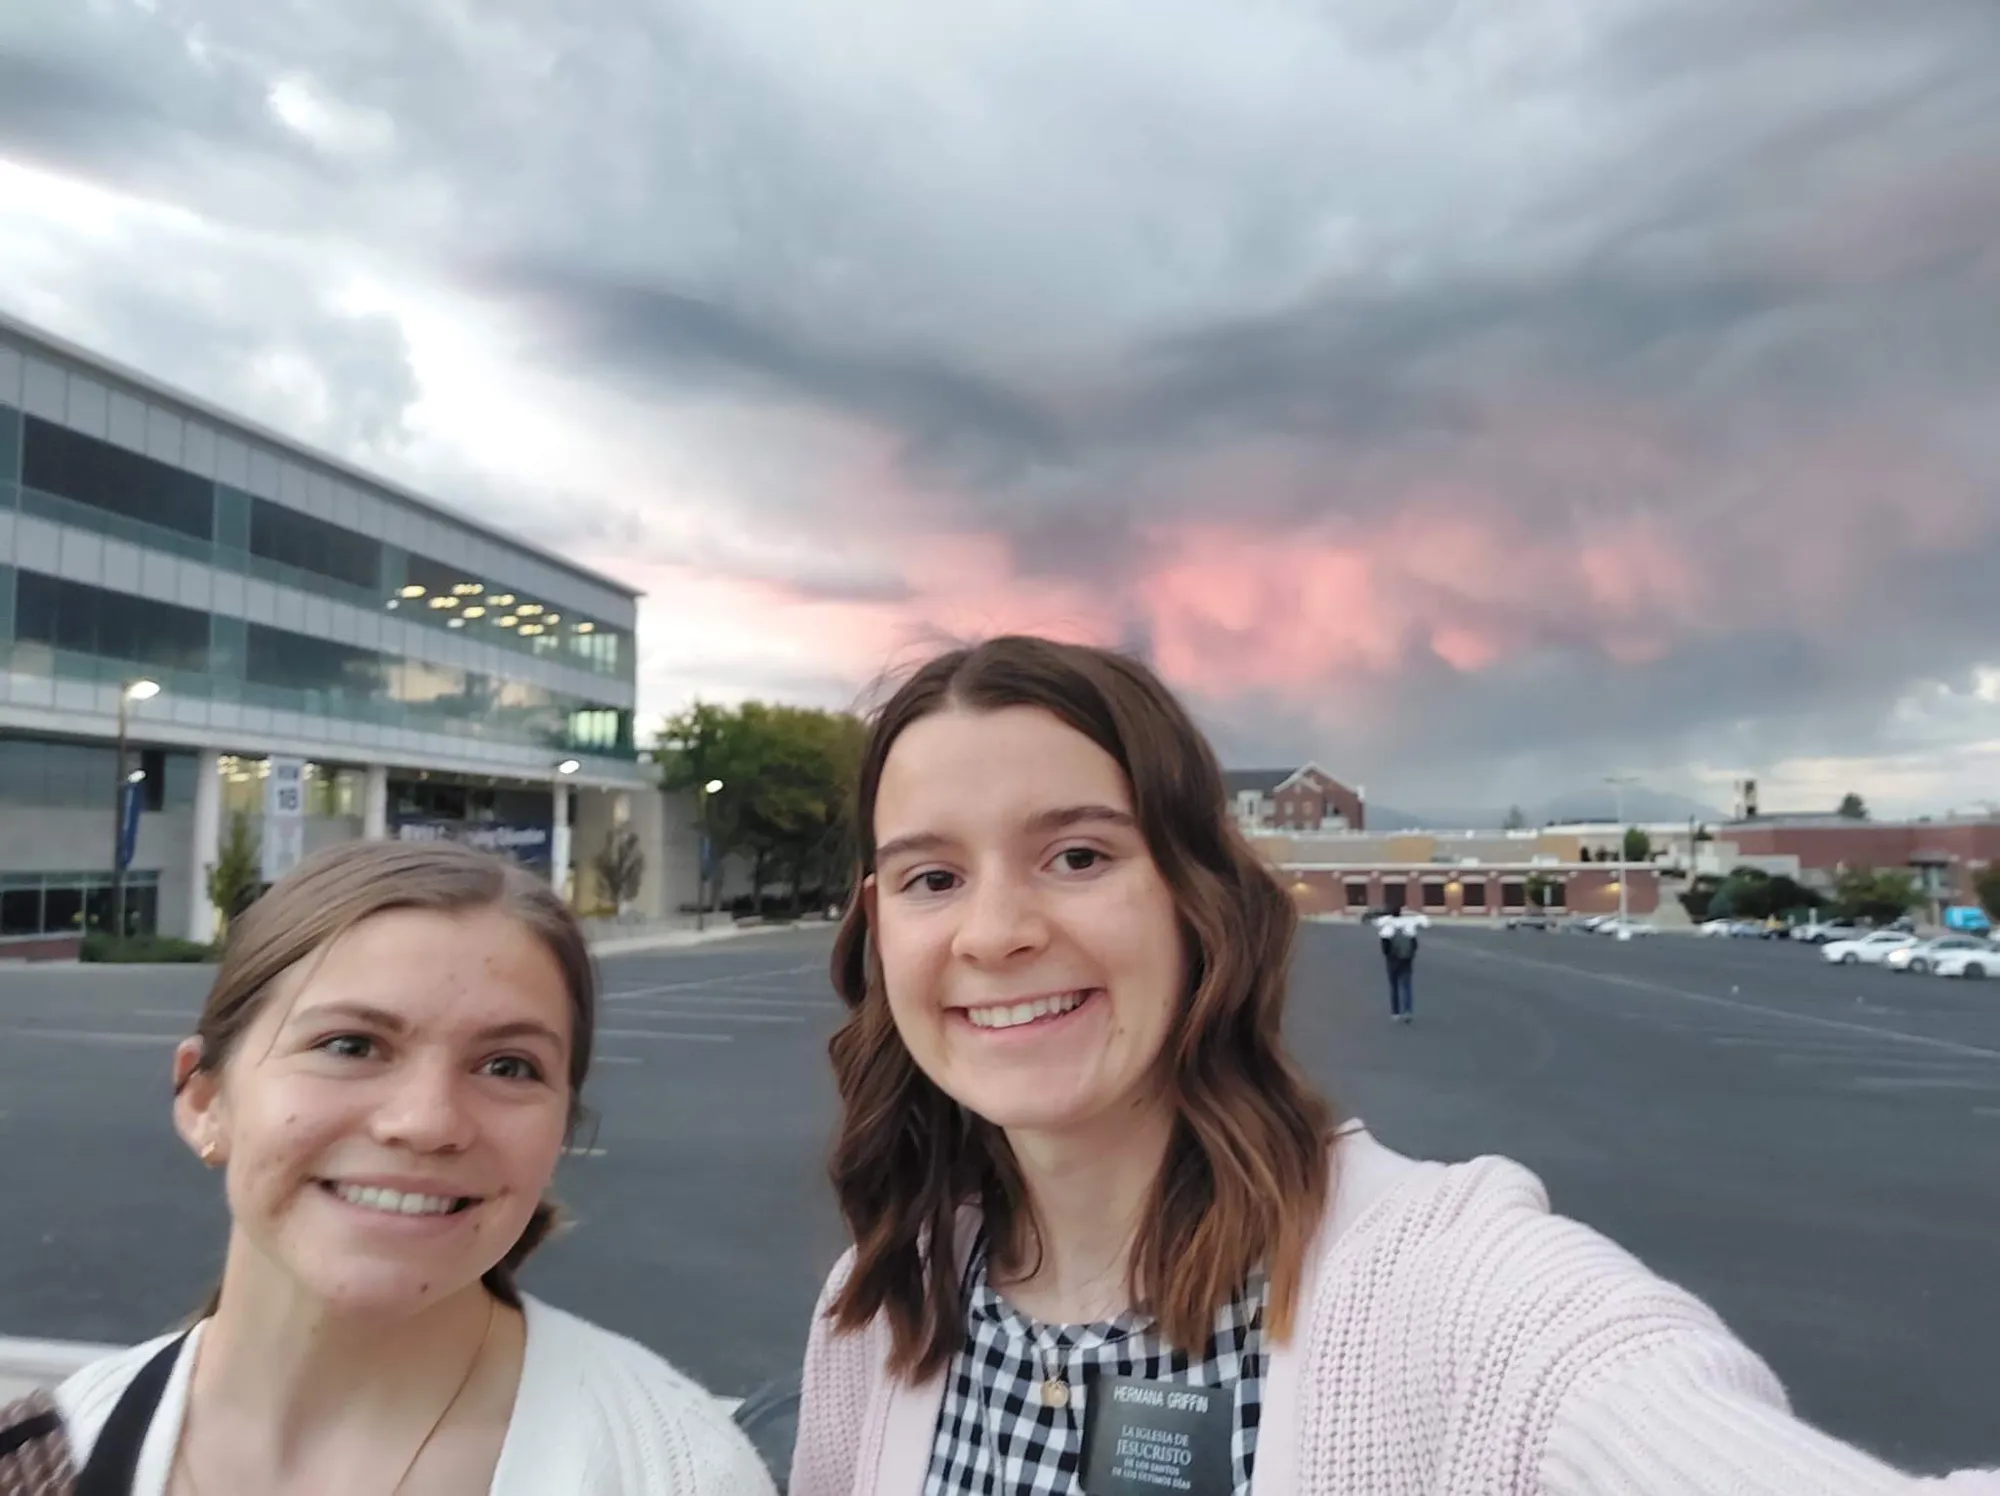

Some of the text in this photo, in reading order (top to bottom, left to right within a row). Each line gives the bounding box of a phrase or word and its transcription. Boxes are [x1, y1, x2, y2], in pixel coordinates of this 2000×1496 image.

[1113, 1386, 1209, 1413] HERMANA GRIFFIN
[1122, 1425, 1190, 1447] LA IGLESIA DE
[1116, 1439, 1191, 1465] JESUCRISTO
